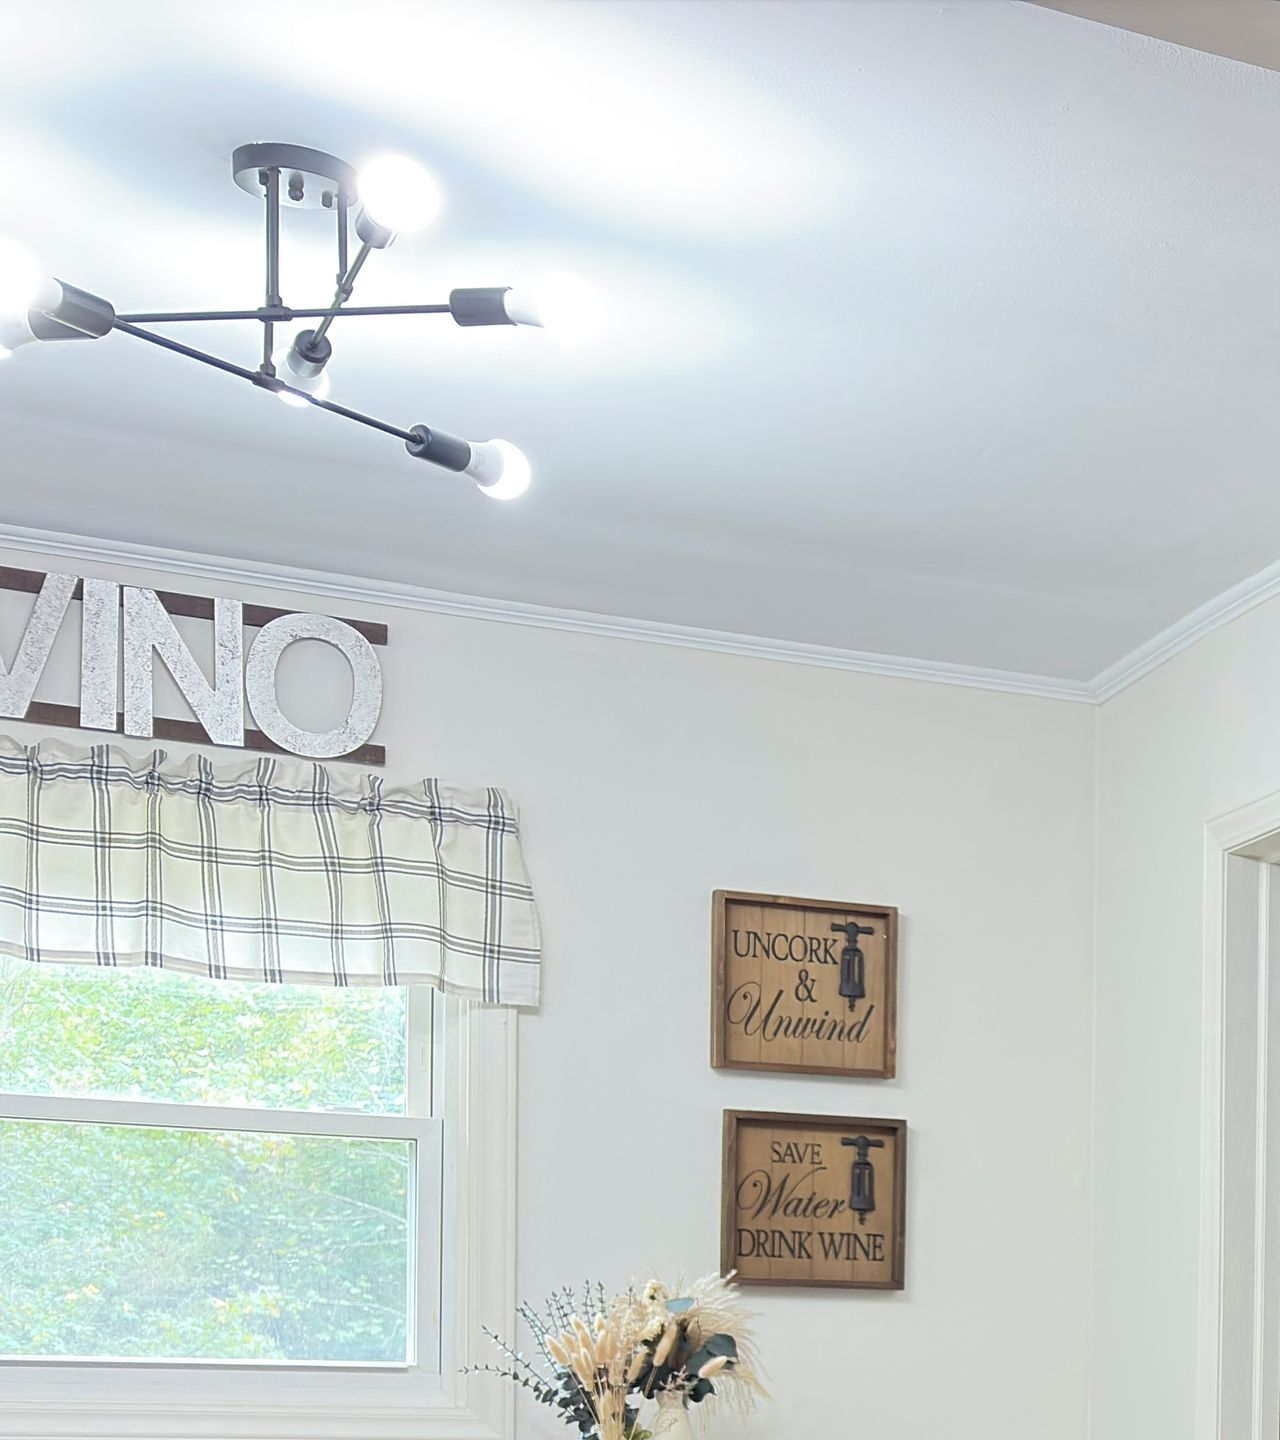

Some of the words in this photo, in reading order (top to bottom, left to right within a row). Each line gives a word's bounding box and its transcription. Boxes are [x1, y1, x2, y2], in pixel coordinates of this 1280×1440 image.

[0, 572, 383, 758] VINO
[732, 929, 839, 965] UNCORK
[794, 968, 818, 1003] &
[727, 981, 875, 1043] Unwind
[770, 1141, 823, 1165] SAVE
[737, 1167, 846, 1220] Water
[736, 1228, 812, 1259] DRINK
[818, 1231, 885, 1262] WINE
